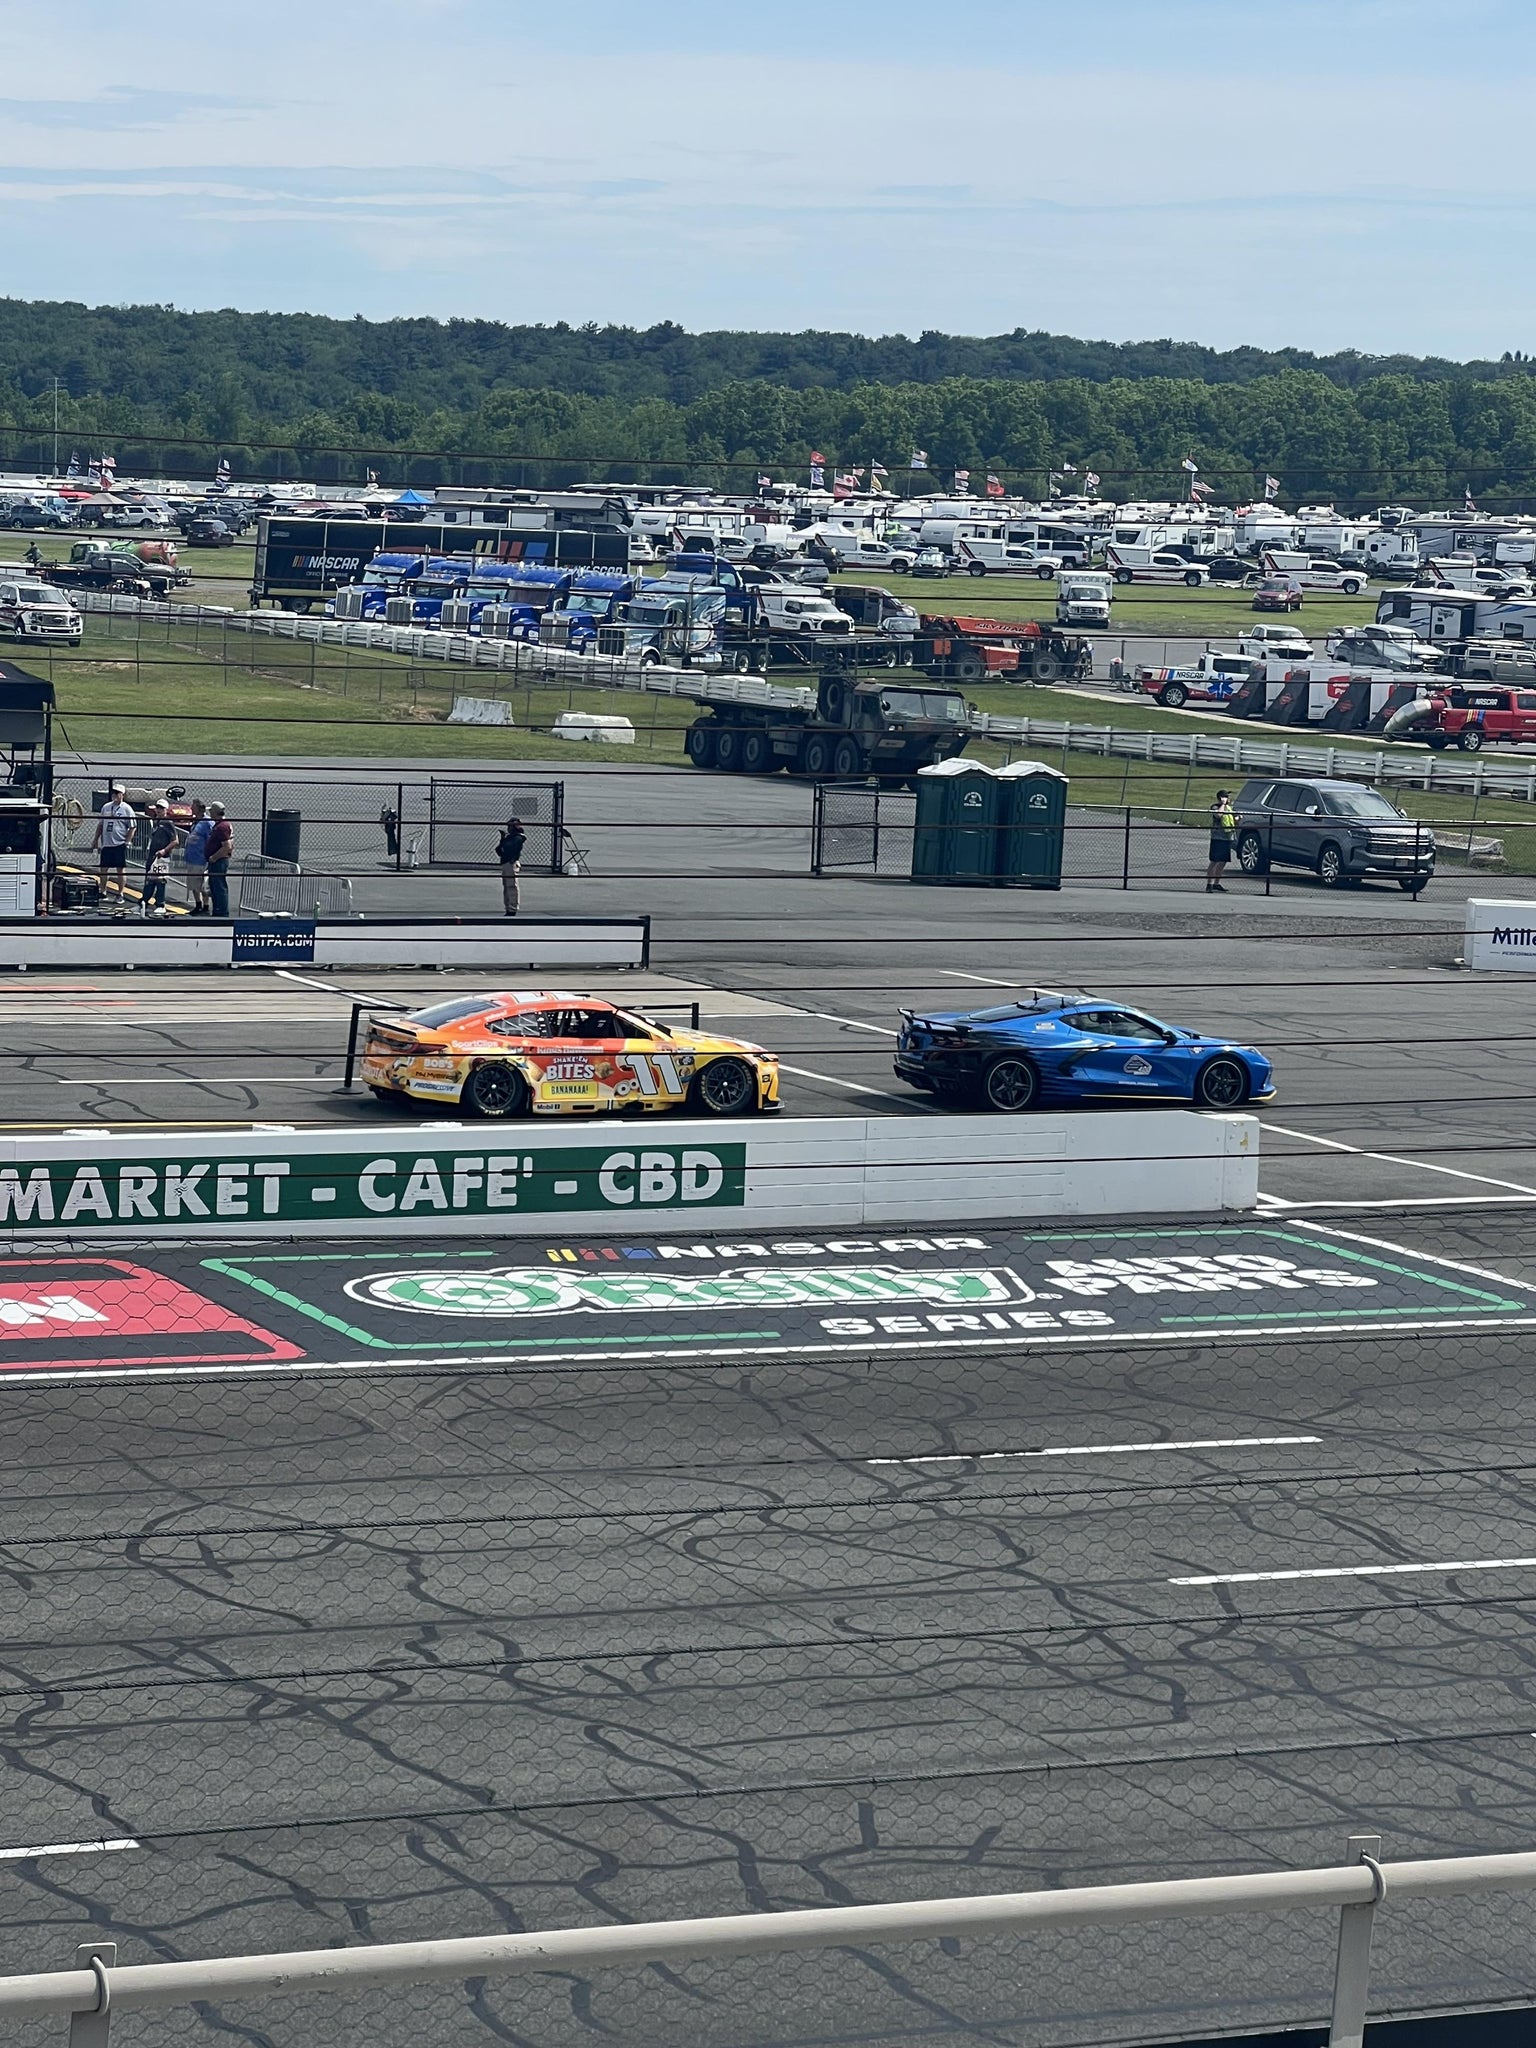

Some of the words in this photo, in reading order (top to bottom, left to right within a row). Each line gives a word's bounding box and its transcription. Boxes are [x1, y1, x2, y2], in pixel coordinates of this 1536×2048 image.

[308, 555, 360, 571] NASCAR
[974, 622, 1028, 633] SKYTRAK
[1175, 671, 1205, 679] NASCAR
[1475, 698, 1499, 706] NASCAR
[235, 934, 313, 947] VISITPA.COM
[424, 1058, 454, 1069] BOB'S
[546, 1064, 595, 1080] BITES
[625, 1054, 683, 1095] 11
[0, 1162, 290, 1221] MARKET
[599, 1150, 724, 1204] CBD
[656, 1237, 993, 1259] NASCAR
[1045, 1254, 1298, 1277] AUTO
[1043, 1269, 1380, 1296] PARTS
[818, 1309, 1116, 1336] SERIES
